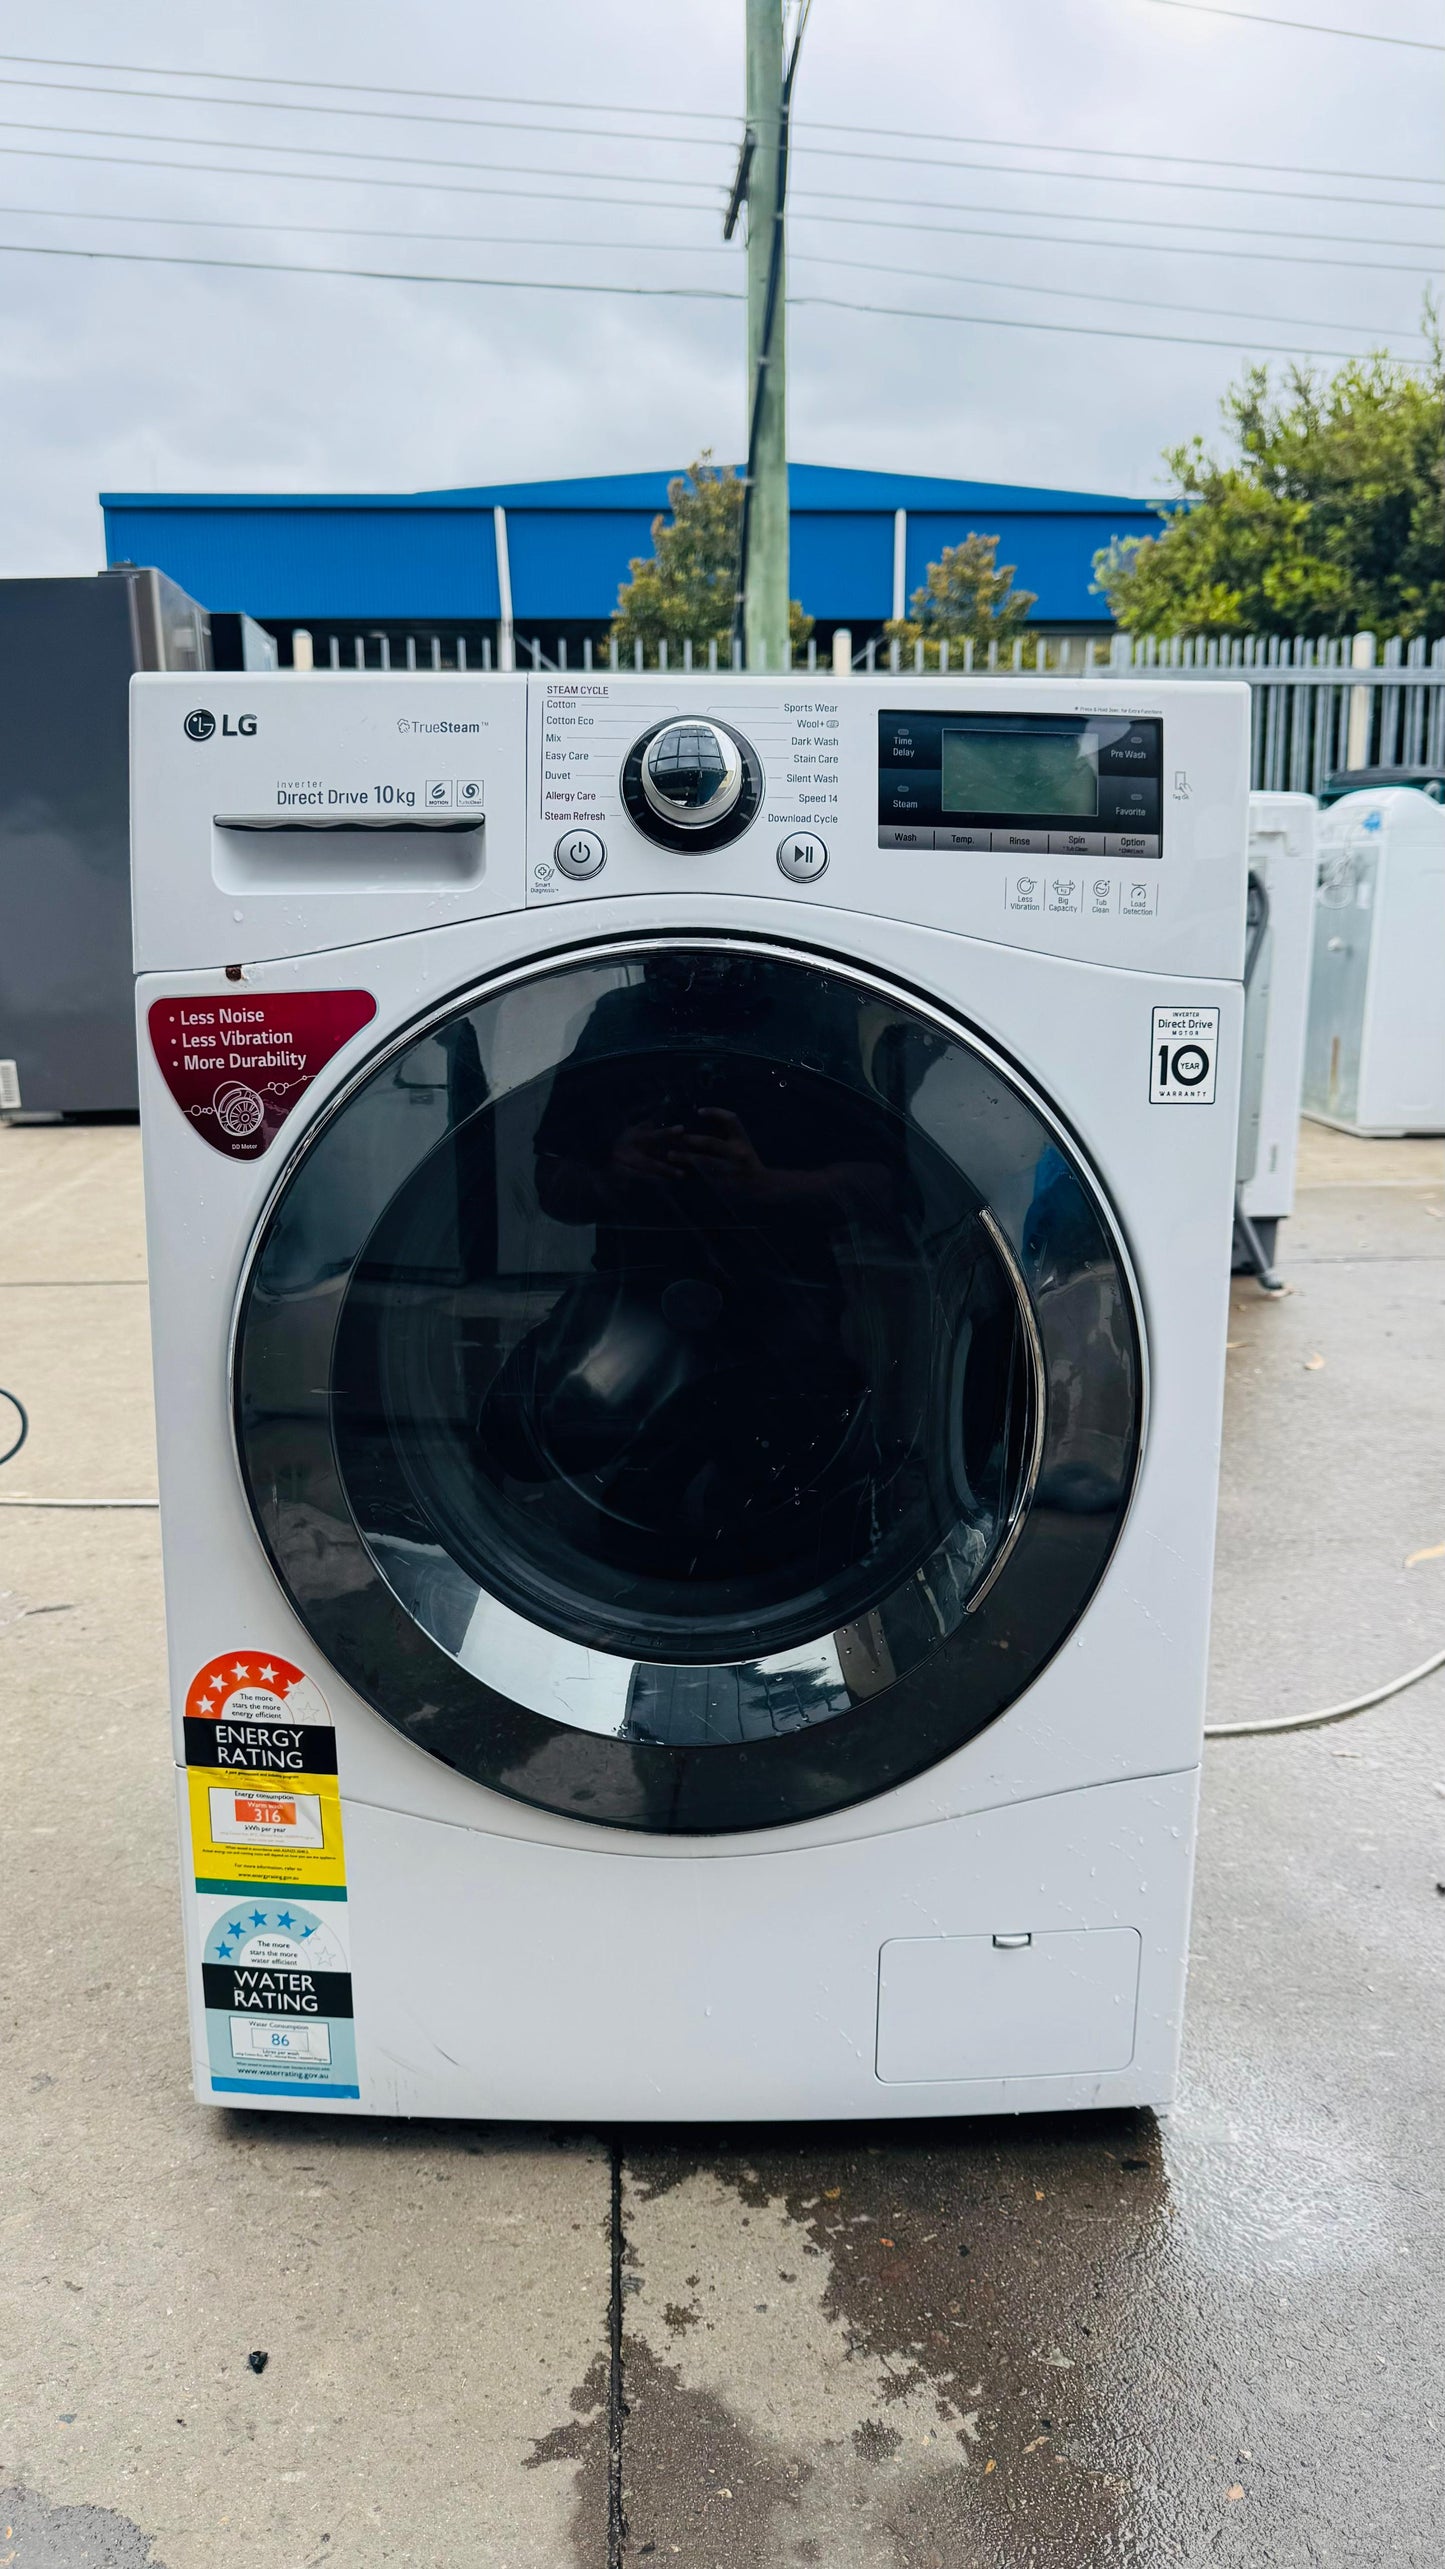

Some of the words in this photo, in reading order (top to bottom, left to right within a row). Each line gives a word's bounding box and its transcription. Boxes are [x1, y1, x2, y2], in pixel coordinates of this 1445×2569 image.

[547, 686, 578, 696] STEAM
[580, 686, 608, 696] CYCLE
[547, 700, 576, 709] Cotton
[784, 703, 814, 714] Sports
[815, 704, 838, 712] Wear
[222, 714, 257, 737] LG
[547, 716, 575, 726] Cotton
[578, 716, 594, 726] Eco
[546, 734, 561, 743] Mix
[791, 737, 811, 746] Dark
[814, 737, 838, 746] Wash
[894, 737, 912, 745] Time
[546, 751, 566, 762] Easy
[568, 752, 589, 761] Care
[893, 748, 914, 758] Delay
[1111, 750, 1124, 759] Pre
[1126, 750, 1146, 760] Wash
[794, 754, 815, 763] Stain
[818, 754, 838, 764] Care
[545, 771, 571, 780] Duvet
[786, 774, 811, 783] Silent
[813, 774, 838, 784] Wash
[276, 790, 324, 805] Direct
[328, 790, 368, 805] Drive
[546, 791, 575, 802] Allergy
[577, 791, 596, 801] Care
[799, 794, 826, 805] Speed
[829, 794, 838, 803] 14
[893, 800, 918, 809] Steam
[545, 812, 572, 821] Steam
[573, 812, 606, 821] Refresh
[1116, 807, 1146, 817] Favorite
[768, 814, 811, 823] Download
[814, 814, 838, 824] Cycle
[894, 832, 917, 843] Wash
[951, 834, 975, 846] Temp.
[1009, 836, 1030, 846] Rinse
[1068, 835, 1086, 846] Spin
[1121, 838, 1146, 847] Option
[1017, 895, 1033, 903] Less
[1058, 897, 1069, 906] Big
[1010, 902, 1040, 911] Vibration
[1048, 904, 1078, 913] Capacity
[1092, 906, 1110, 914] Clean
[1123, 908, 1153, 916] Detection
[180, 1010, 215, 1026] Less
[219, 1008, 265, 1024] Noise
[1158, 1020, 1186, 1029] Direct
[1188, 1020, 1213, 1029] Drive
[182, 1033, 216, 1048] Less
[220, 1030, 293, 1046] Vibration
[184, 1055, 225, 1070] More
[229, 1052, 307, 1070] Durability
[1158, 1045, 1209, 1086] 10
[216, 1725, 304, 1748] ENERGY
[218, 1747, 304, 1769] RATING
[254, 1809, 281, 1823] 316
[234, 1970, 315, 1992] WATER
[234, 1990, 318, 2012] RATING
[271, 2033, 290, 2046] 86
[237, 2067, 329, 2080] www.waterrating.gov.au
